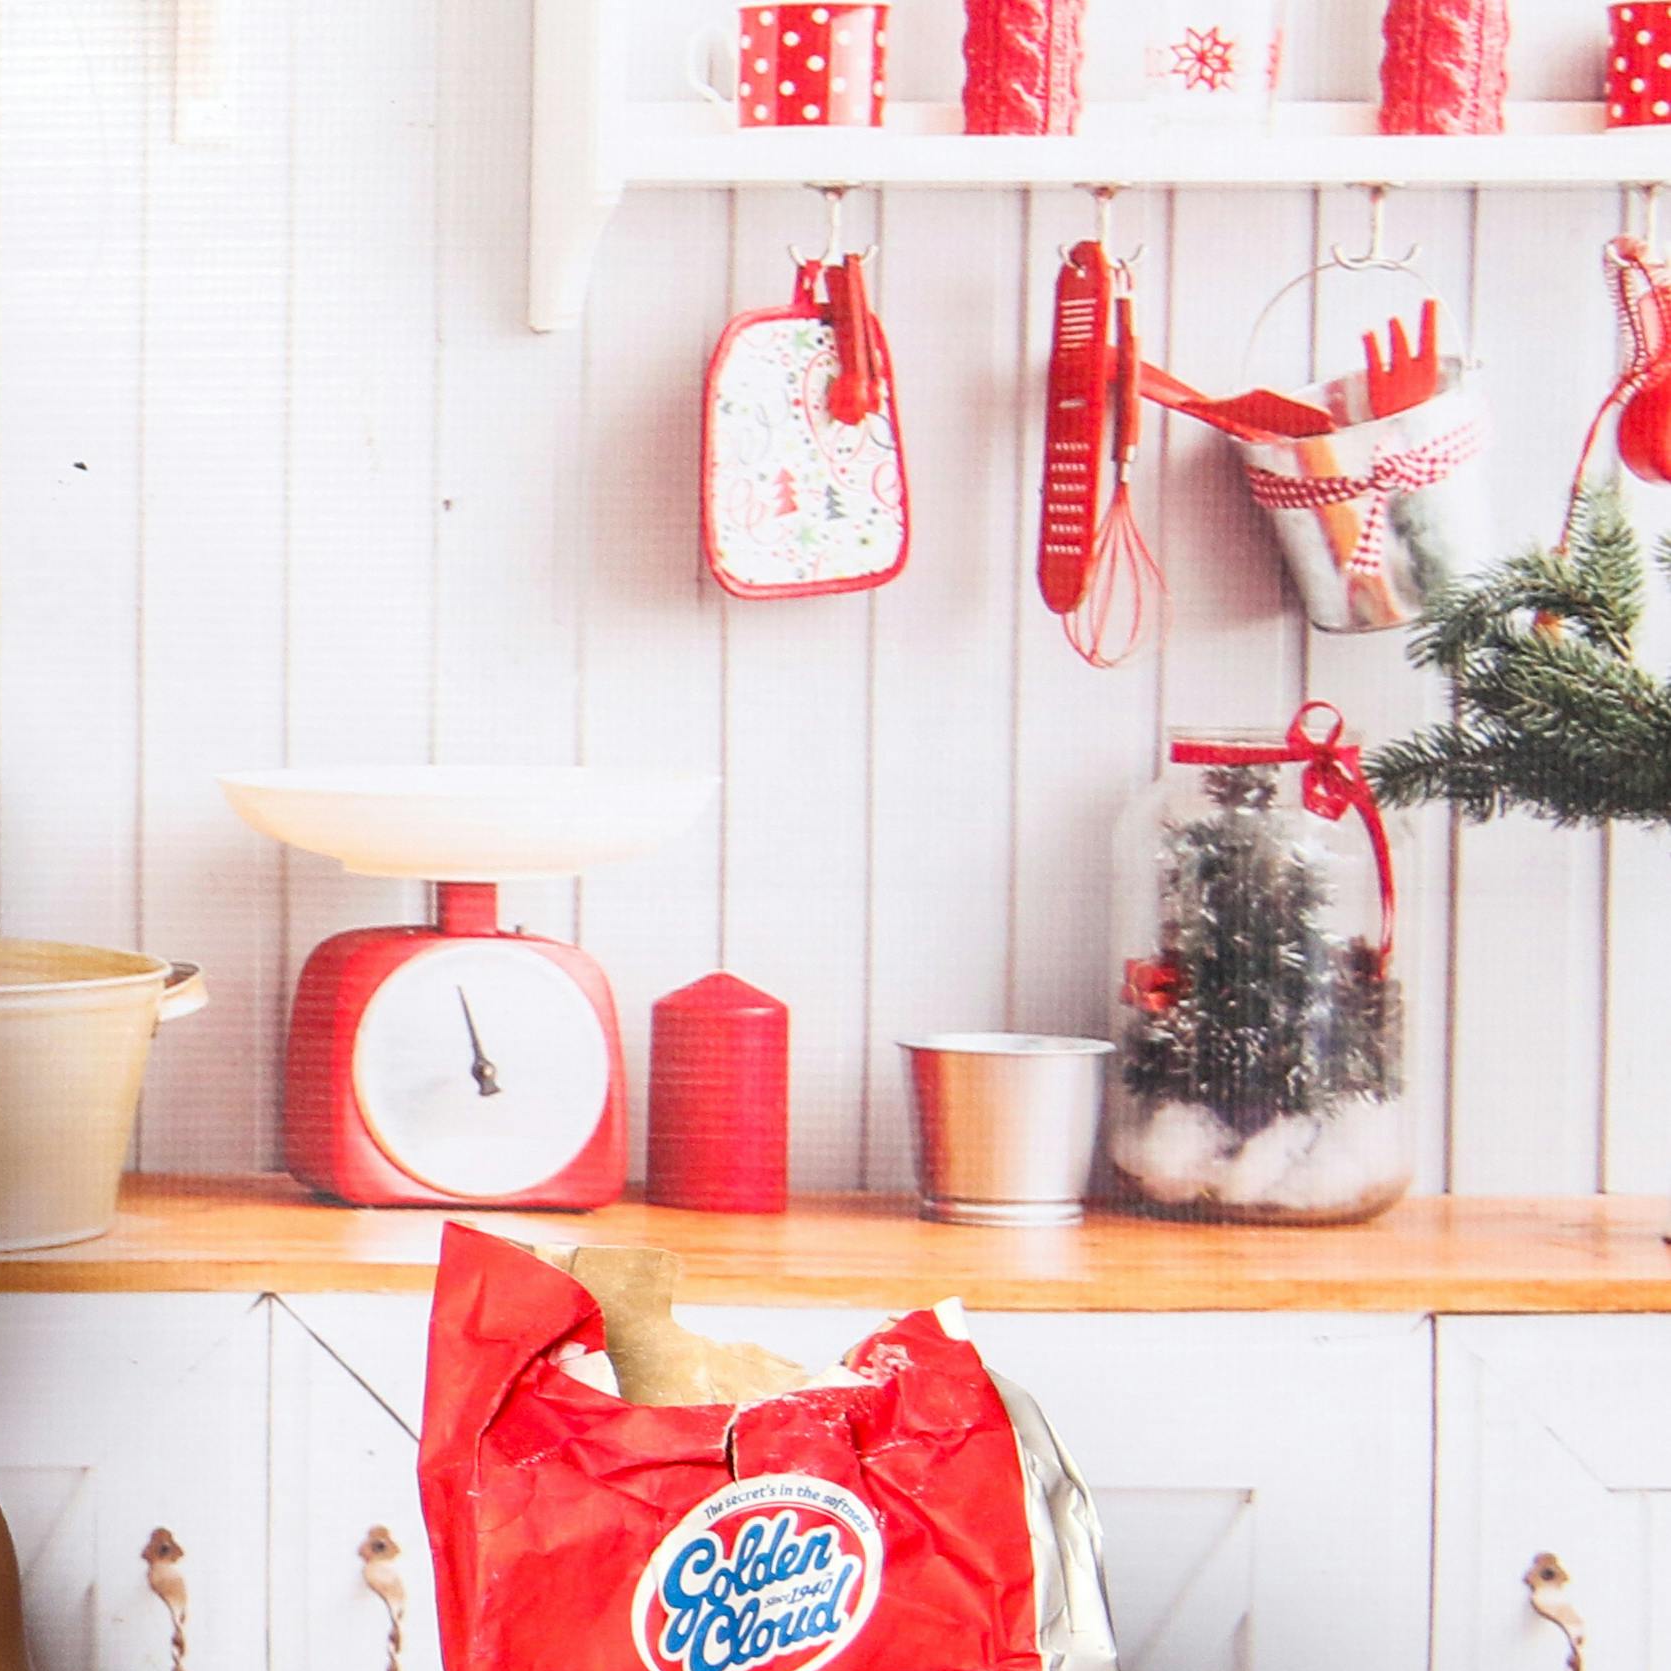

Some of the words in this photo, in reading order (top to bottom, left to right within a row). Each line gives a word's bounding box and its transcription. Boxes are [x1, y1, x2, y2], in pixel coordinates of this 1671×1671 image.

[703, 1502, 723, 1520] The
[725, 1485, 776, 1508] secret's
[779, 1484, 793, 1496] in
[797, 1486, 820, 1501] the
[822, 1495, 870, 1534] softness
[663, 1517, 832, 1654] Golden
[789, 1578, 832, 1605] 1940
